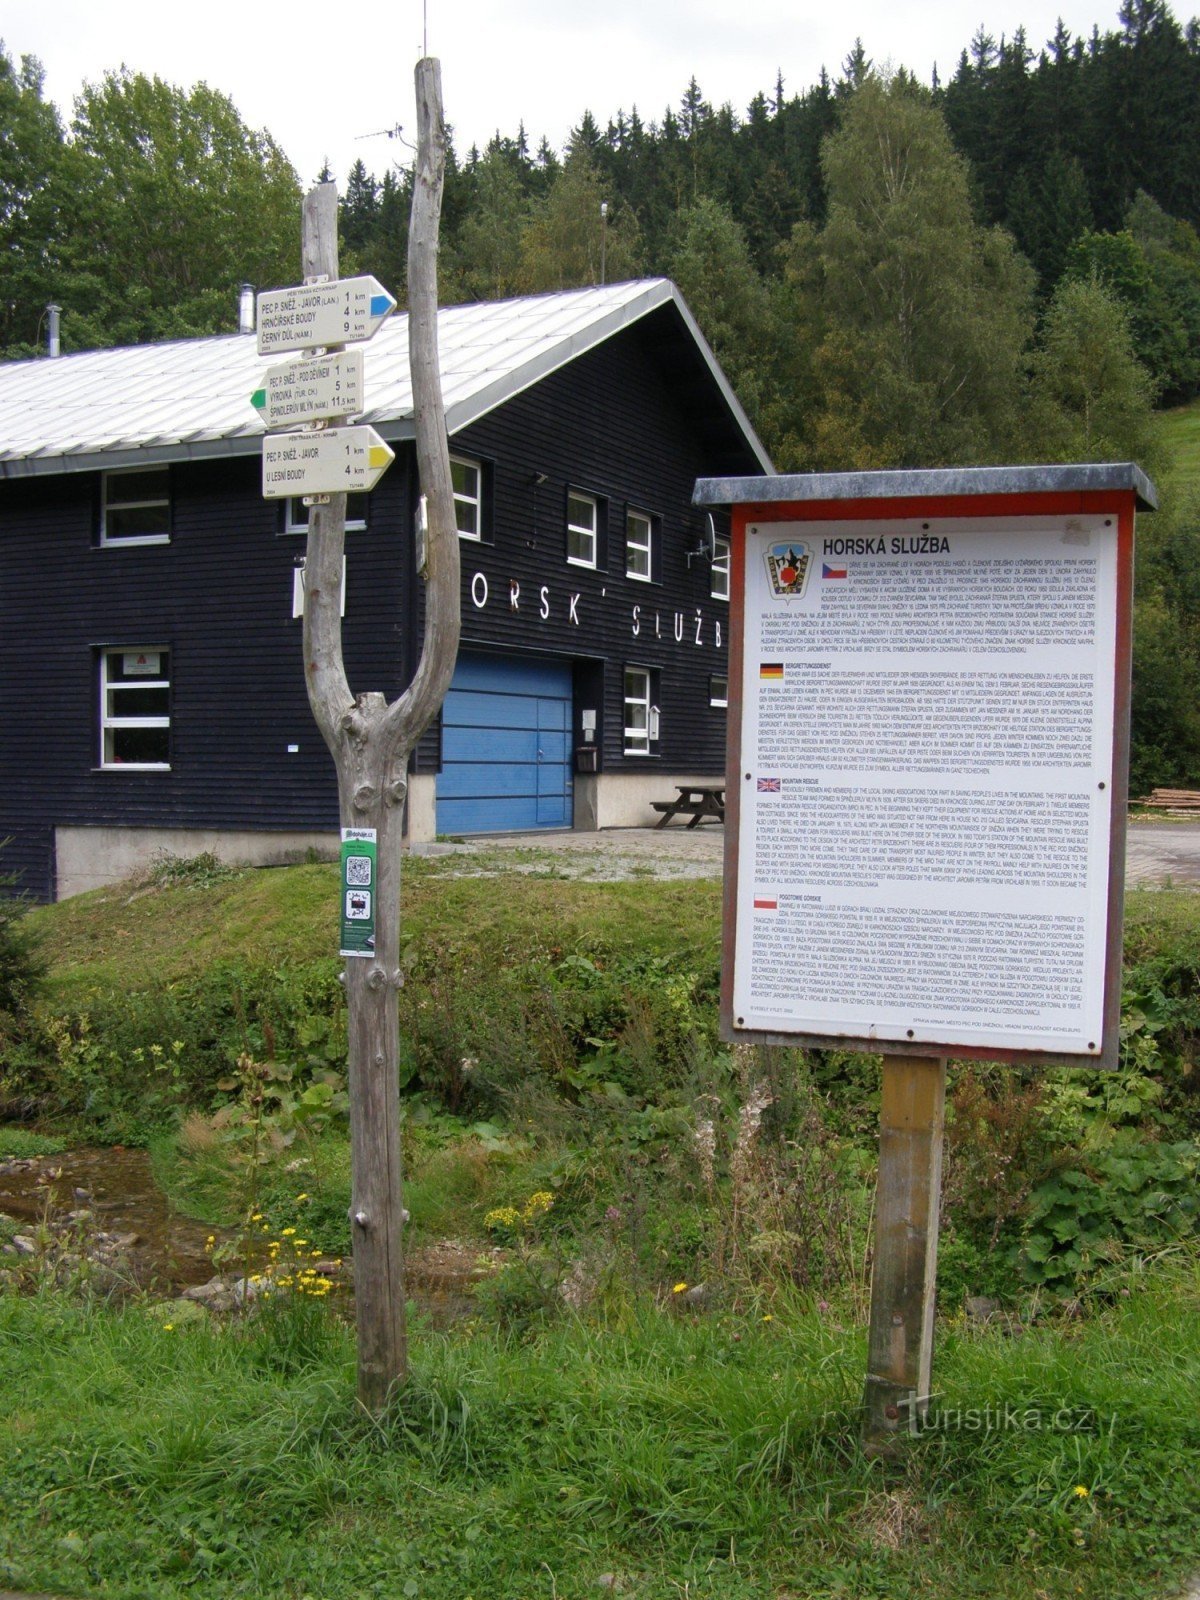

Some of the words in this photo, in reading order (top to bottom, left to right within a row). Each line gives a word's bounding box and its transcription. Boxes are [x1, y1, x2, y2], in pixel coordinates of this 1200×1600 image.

[262, 304, 273, 314] PEC
[302, 296, 320, 308] JAVOR
[345, 292, 350, 302] 1
[296, 312, 316, 324] BOUDY
[344, 306, 350, 316] 4
[262, 330, 282, 344] ČERNÝ
[344, 322, 350, 332] 9
[336, 365, 340, 375] 1
[336, 380, 340, 390] 5
[266, 452, 276, 462] PEC
[302, 447, 319, 459] JAVOR
[345, 445, 350, 455] 1
[266, 472, 270, 482] U
[272, 468, 286, 482] LESNÍ
[287, 468, 306, 480] BOUDY
[345, 464, 350, 474] 4
[823, 534, 886, 555] HORSKÁ
[891, 534, 950, 554] SLUŽBA
[632, 604, 722, 648] SLUŽB
